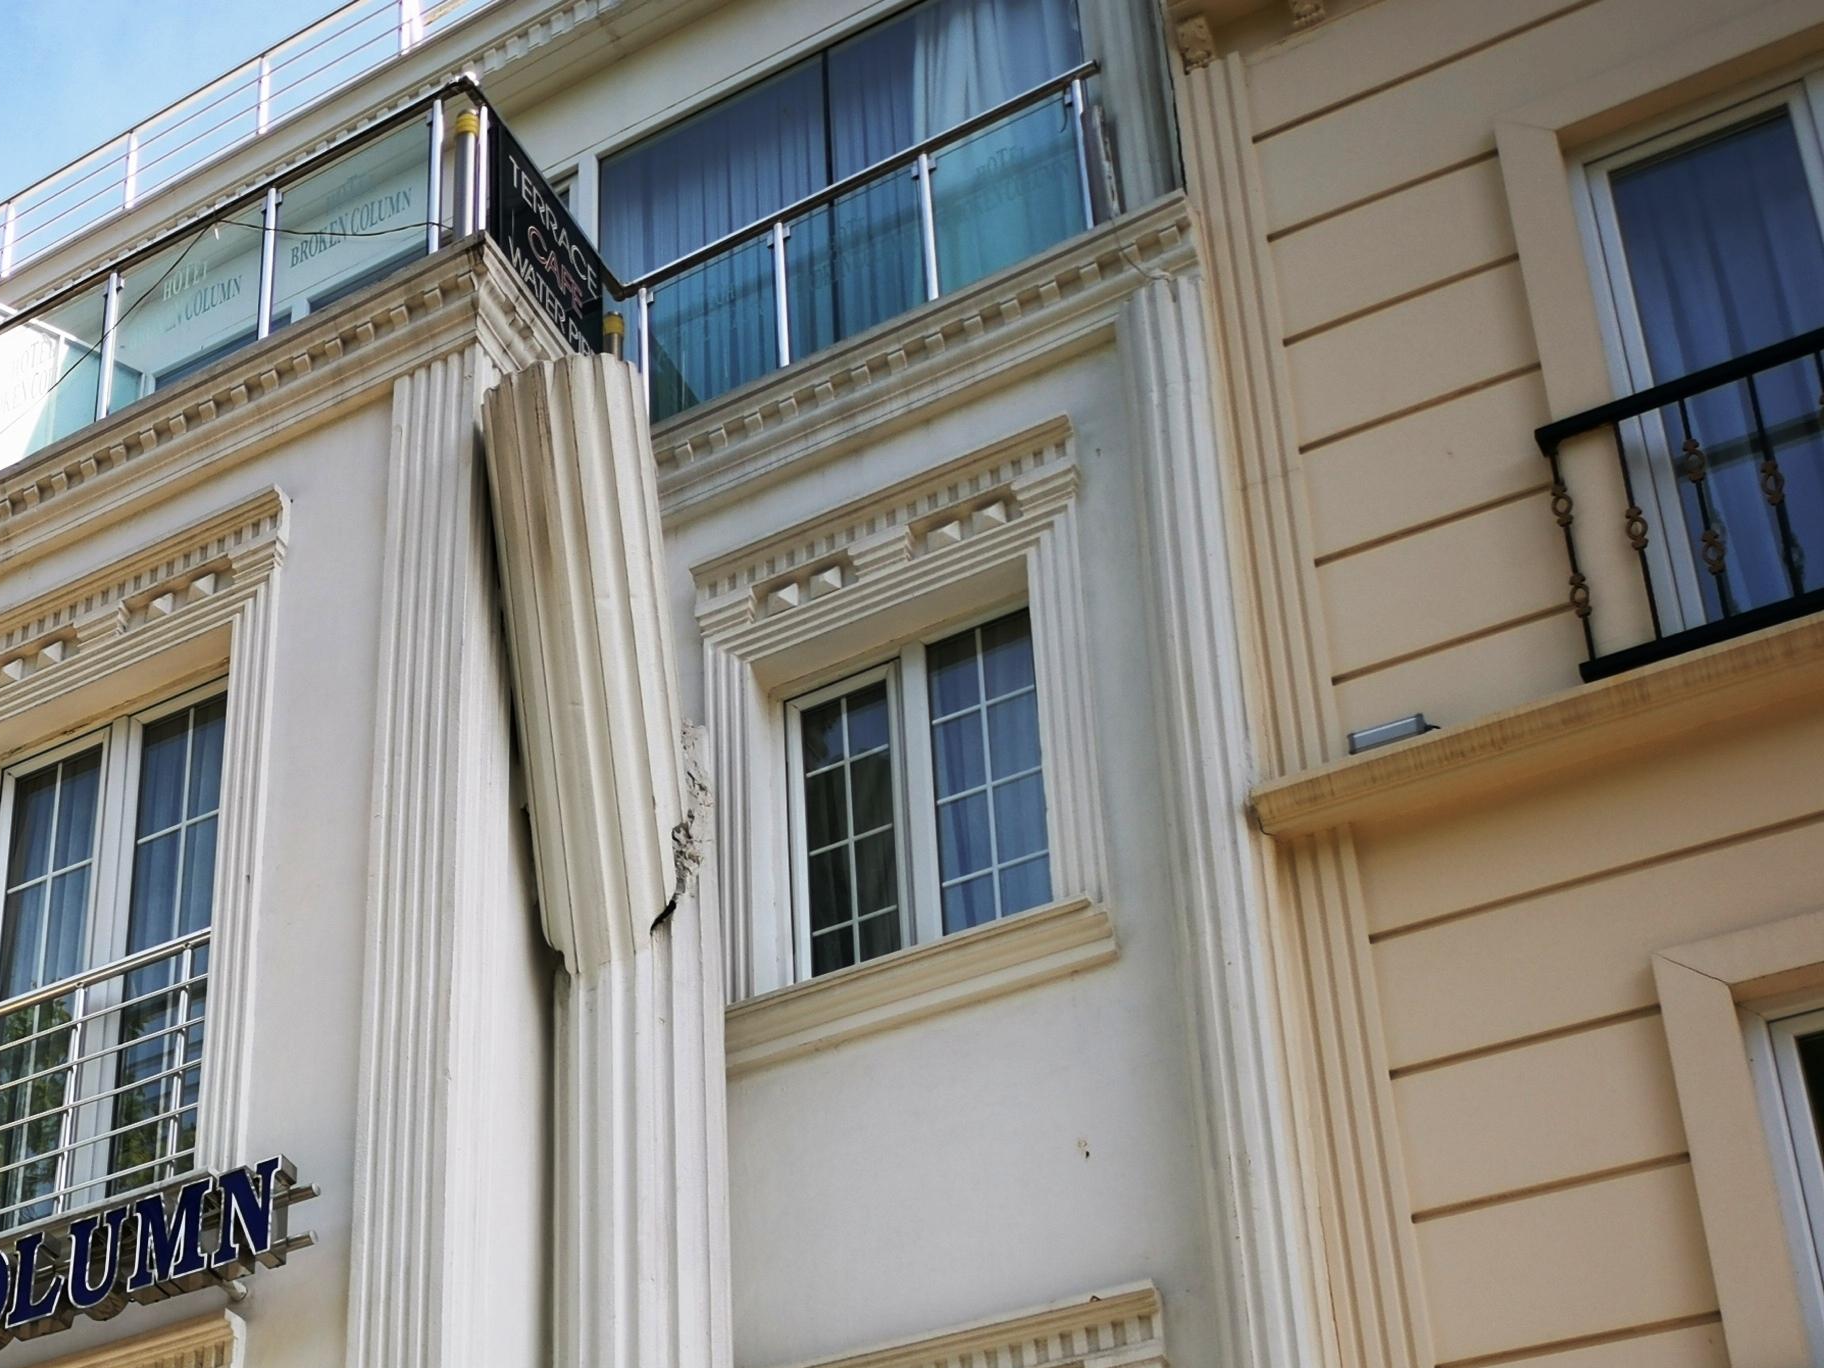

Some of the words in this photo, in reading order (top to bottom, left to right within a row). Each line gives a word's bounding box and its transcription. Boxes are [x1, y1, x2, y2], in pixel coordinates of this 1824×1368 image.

[290, 213, 348, 268] BROKEN
[351, 187, 413, 235] COLUMN
[508, 154, 598, 300] TERRACE
[528, 225, 583, 320] CAFE
[163, 261, 207, 301] HOTEL
[508, 235, 566, 334] WATER
[568, 316, 596, 357] PIP
